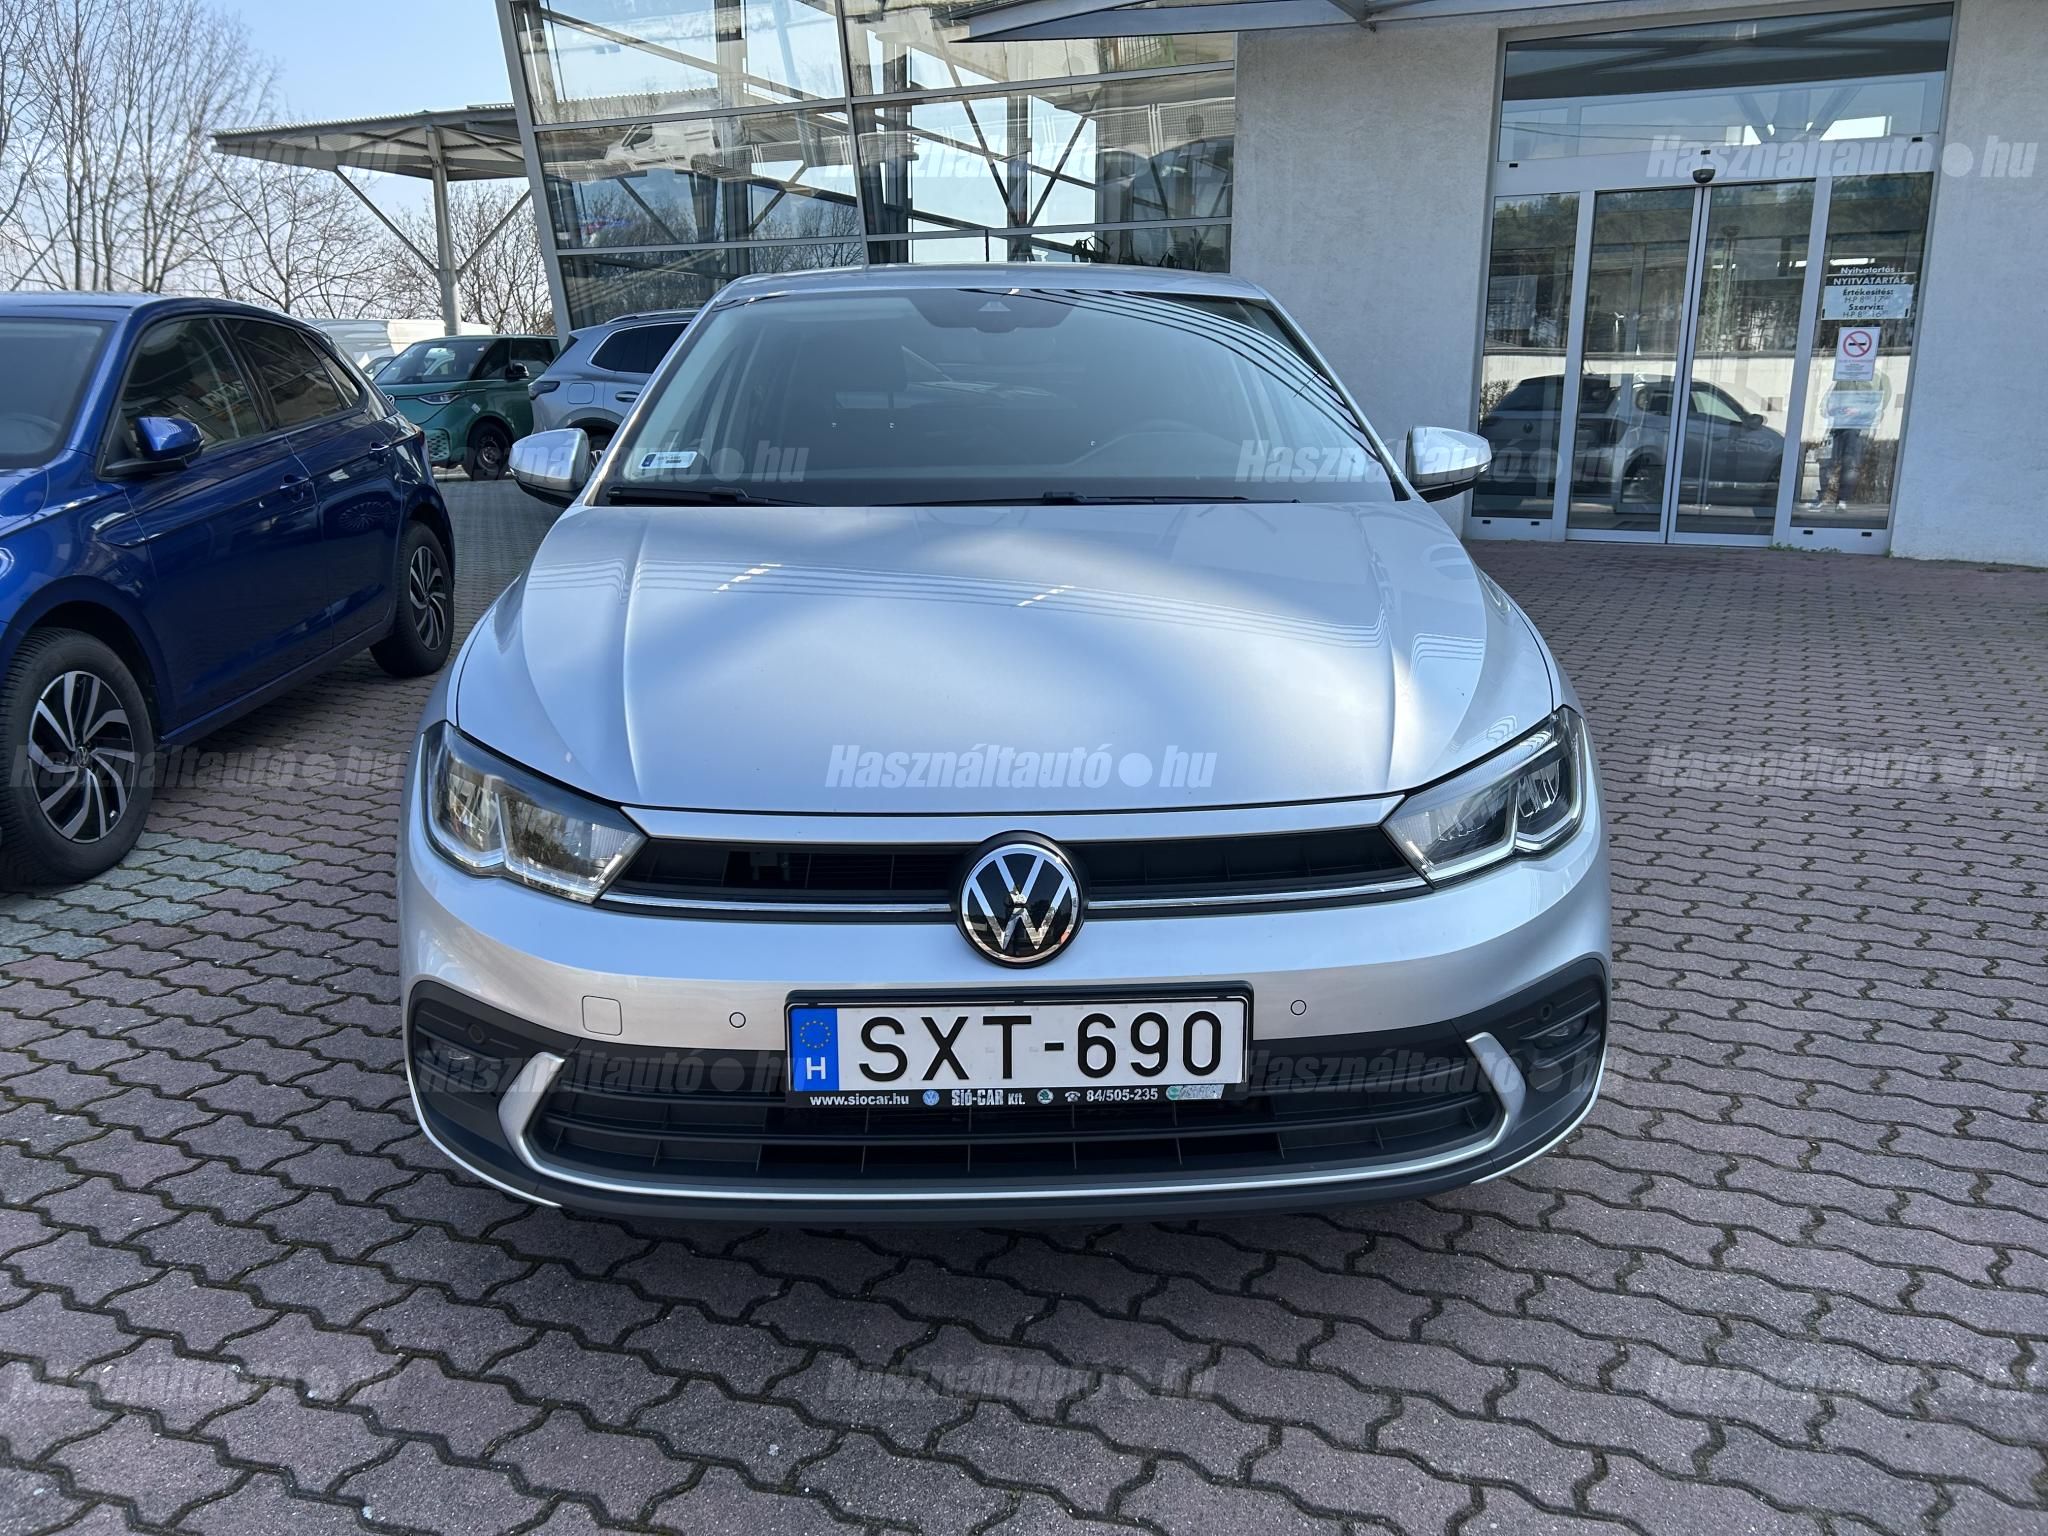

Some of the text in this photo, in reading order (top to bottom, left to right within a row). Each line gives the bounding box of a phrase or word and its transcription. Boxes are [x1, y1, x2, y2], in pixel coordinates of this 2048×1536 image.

[1833, 273, 1907, 286] NYITVATARTÁS
[1848, 302, 1884, 311] Szerviz:
[858, 1010, 1222, 1082] SXT-690
[806, 1057, 827, 1081] H
[809, 1092, 909, 1106] www.siocar.hu
[1086, 1088, 1158, 1101] 84/505-235
